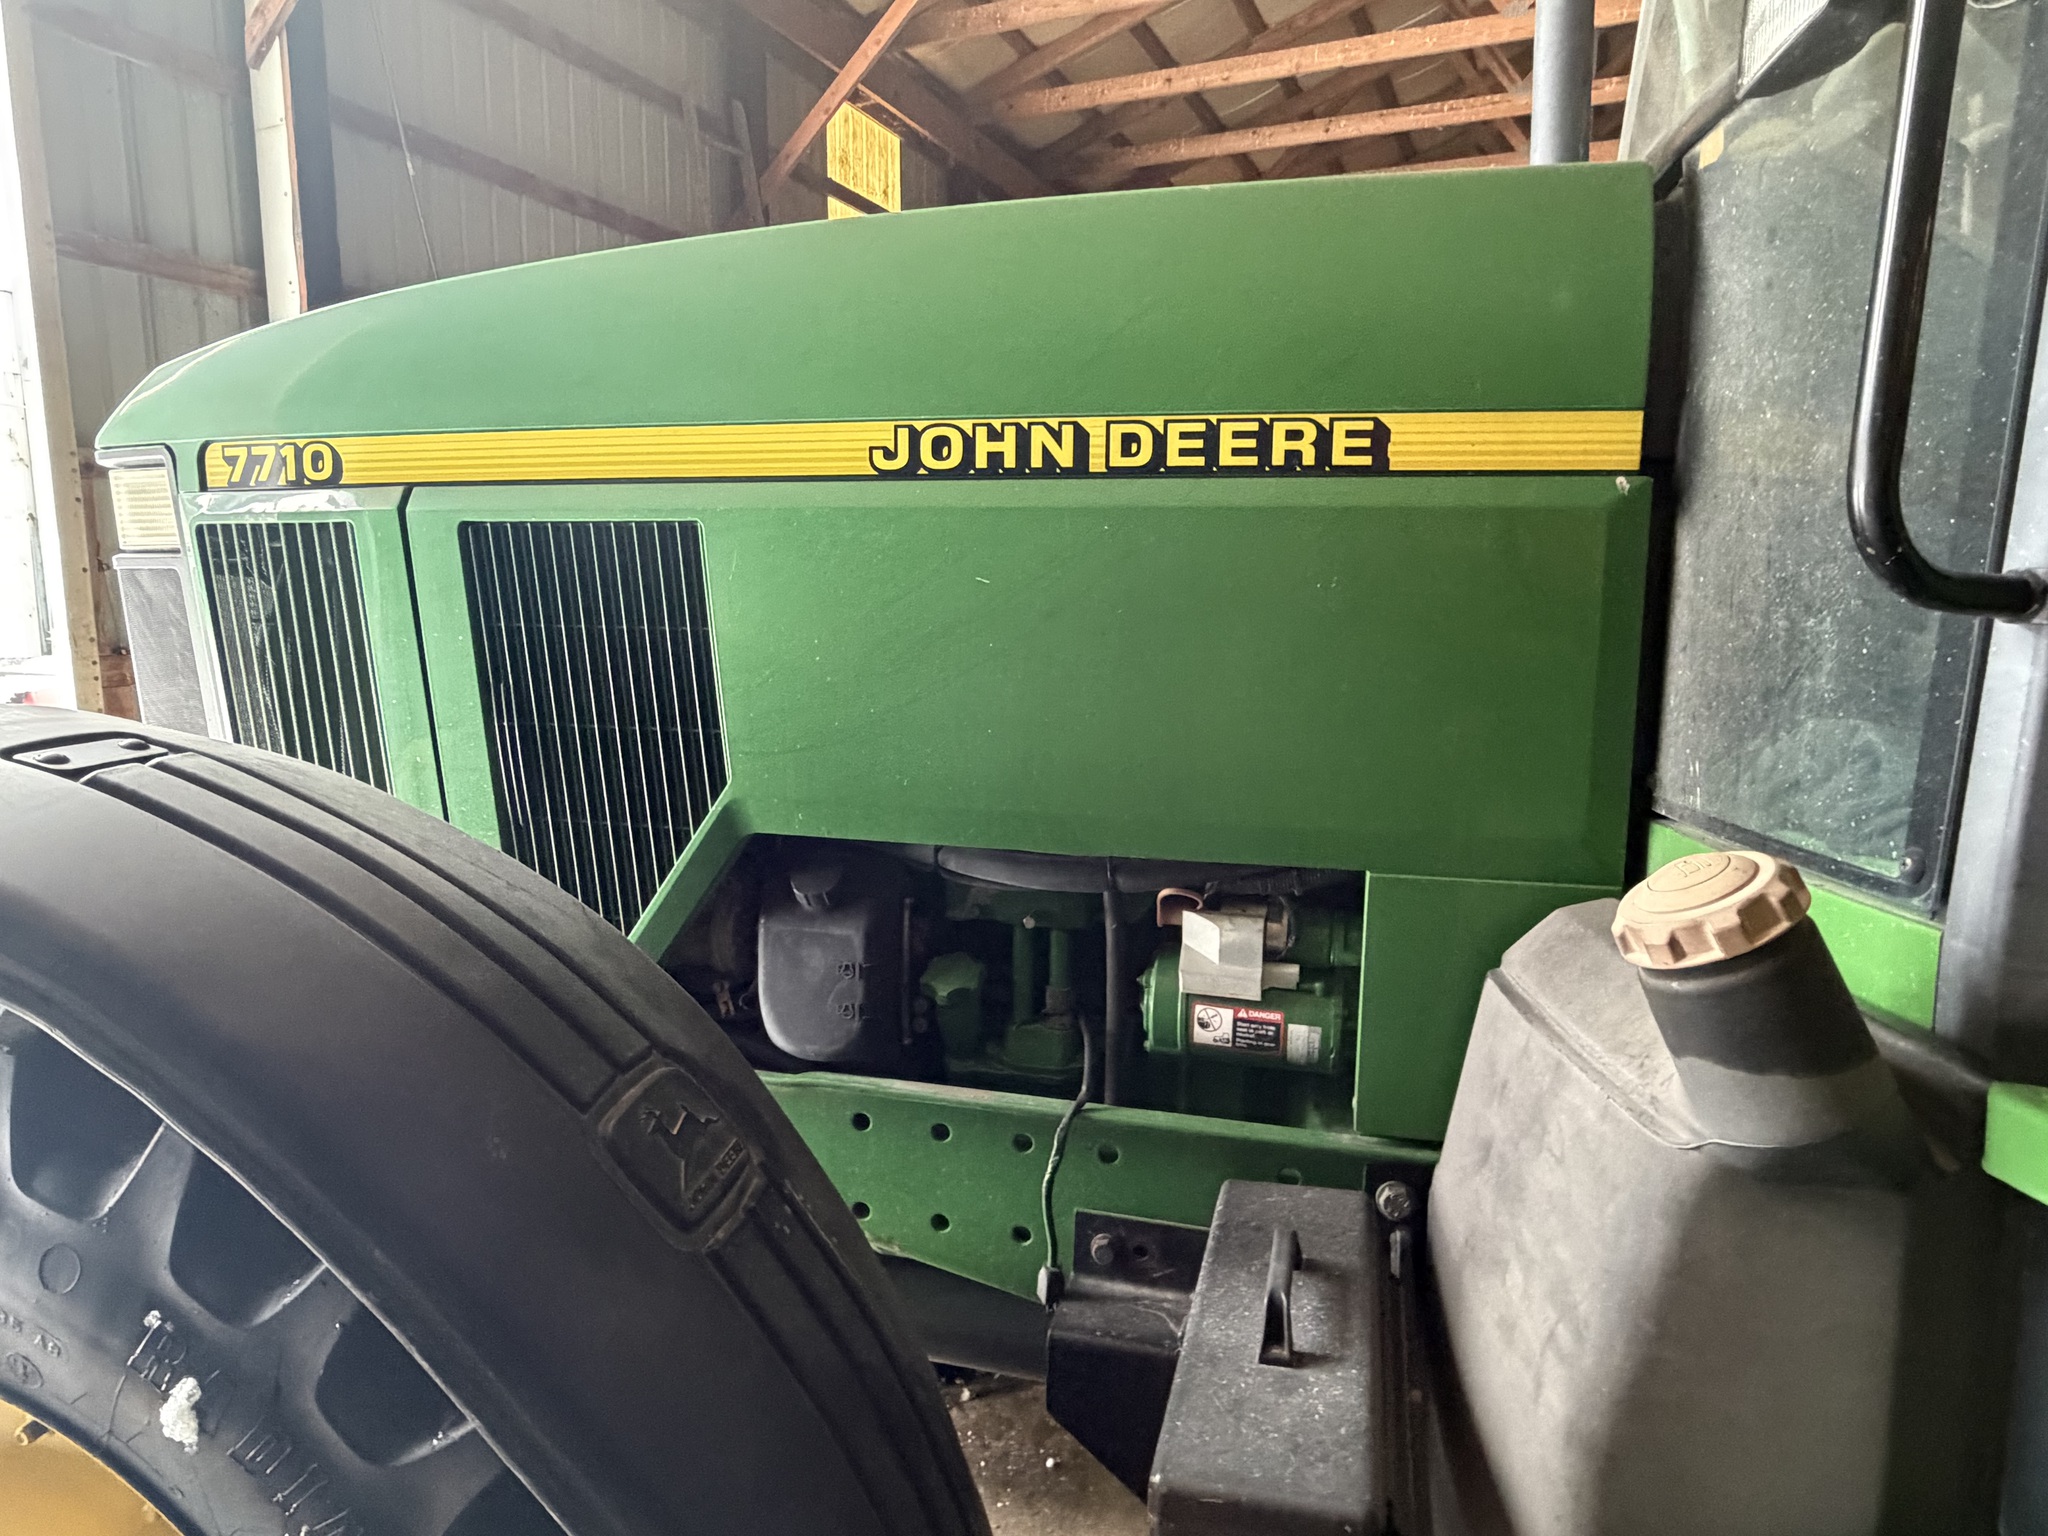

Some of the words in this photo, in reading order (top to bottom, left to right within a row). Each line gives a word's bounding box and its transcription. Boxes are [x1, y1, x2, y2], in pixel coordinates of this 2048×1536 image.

[222, 441, 340, 485] 7710
[870, 419, 1084, 473] JOHN
[1106, 416, 1384, 471] DEERE
[1248, 1010, 1282, 1021] DANGER
